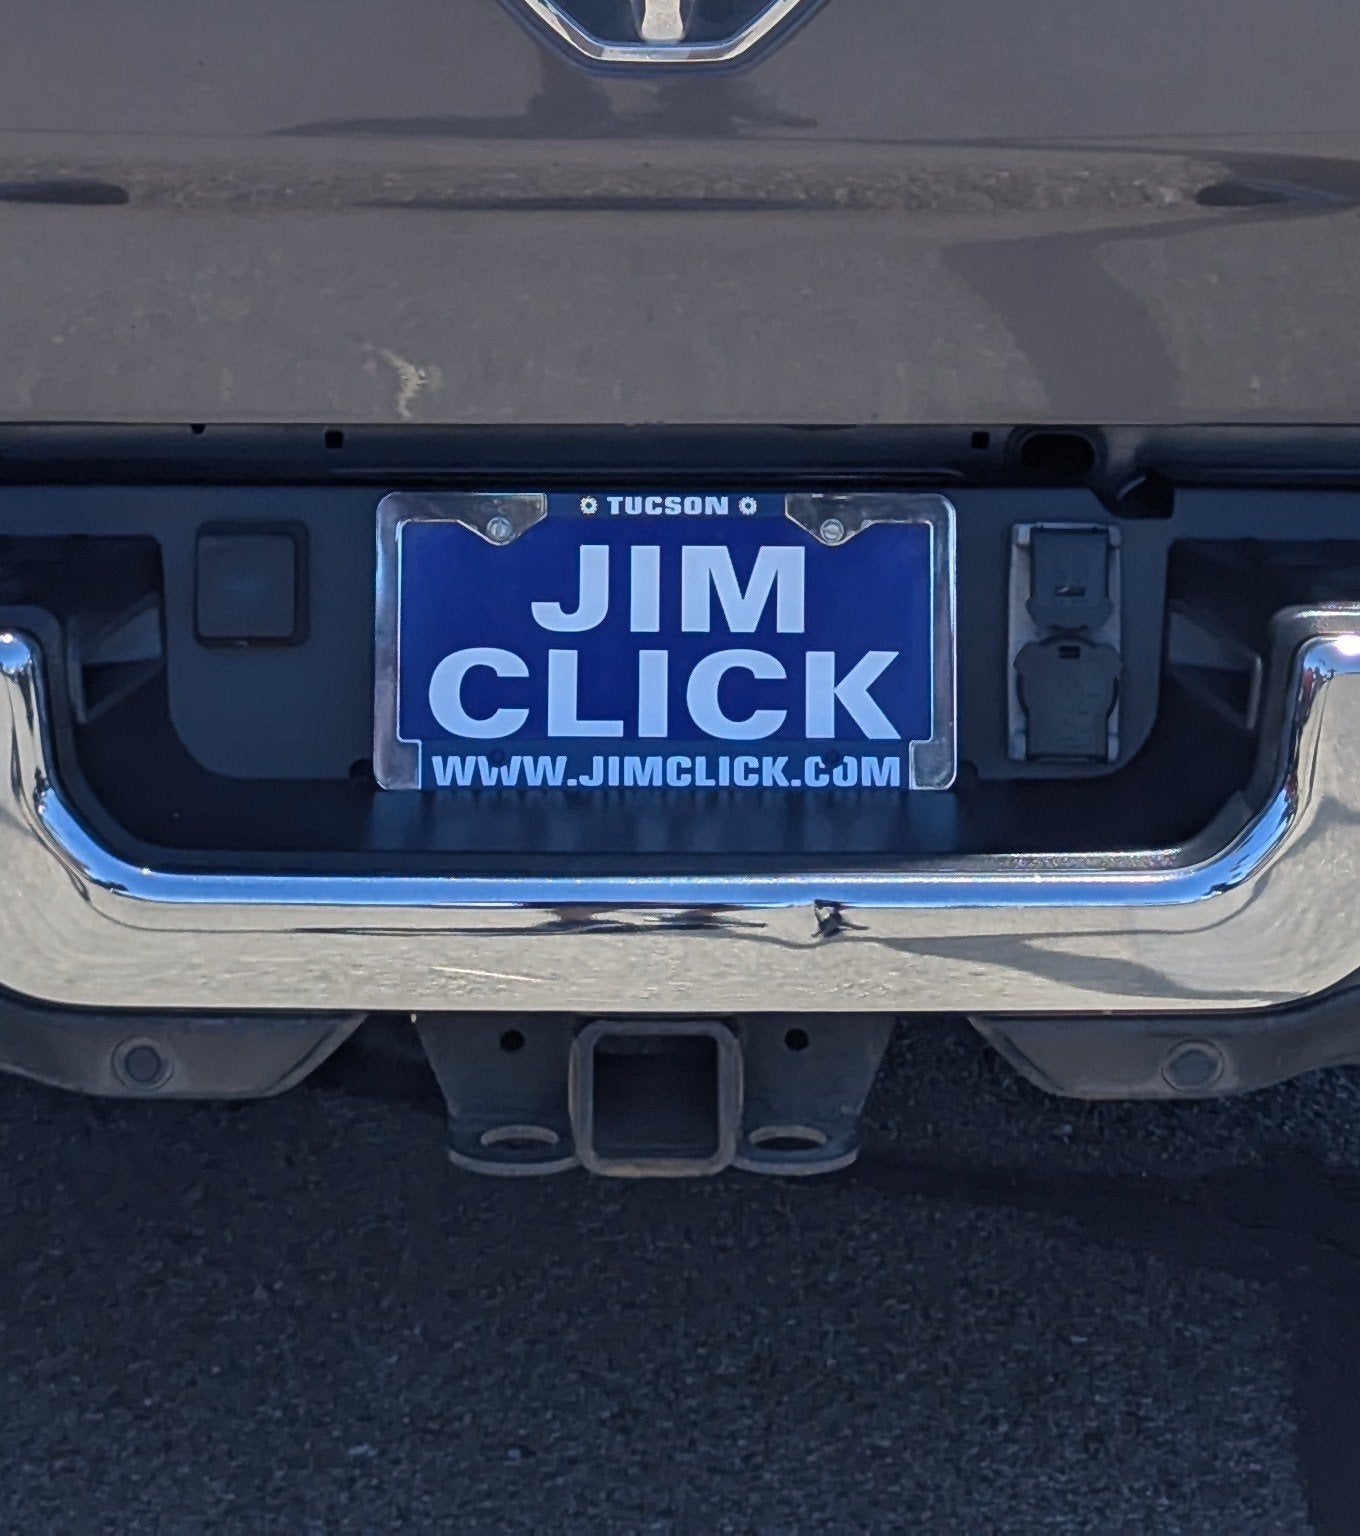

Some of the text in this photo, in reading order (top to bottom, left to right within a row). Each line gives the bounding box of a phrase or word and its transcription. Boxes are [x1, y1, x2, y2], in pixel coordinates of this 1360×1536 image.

[606, 495, 730, 516] TUCSON
[530, 544, 806, 634] JIM
[428, 647, 902, 741] CLICK
[431, 755, 901, 787] WWW.JIMCLICK.COM
